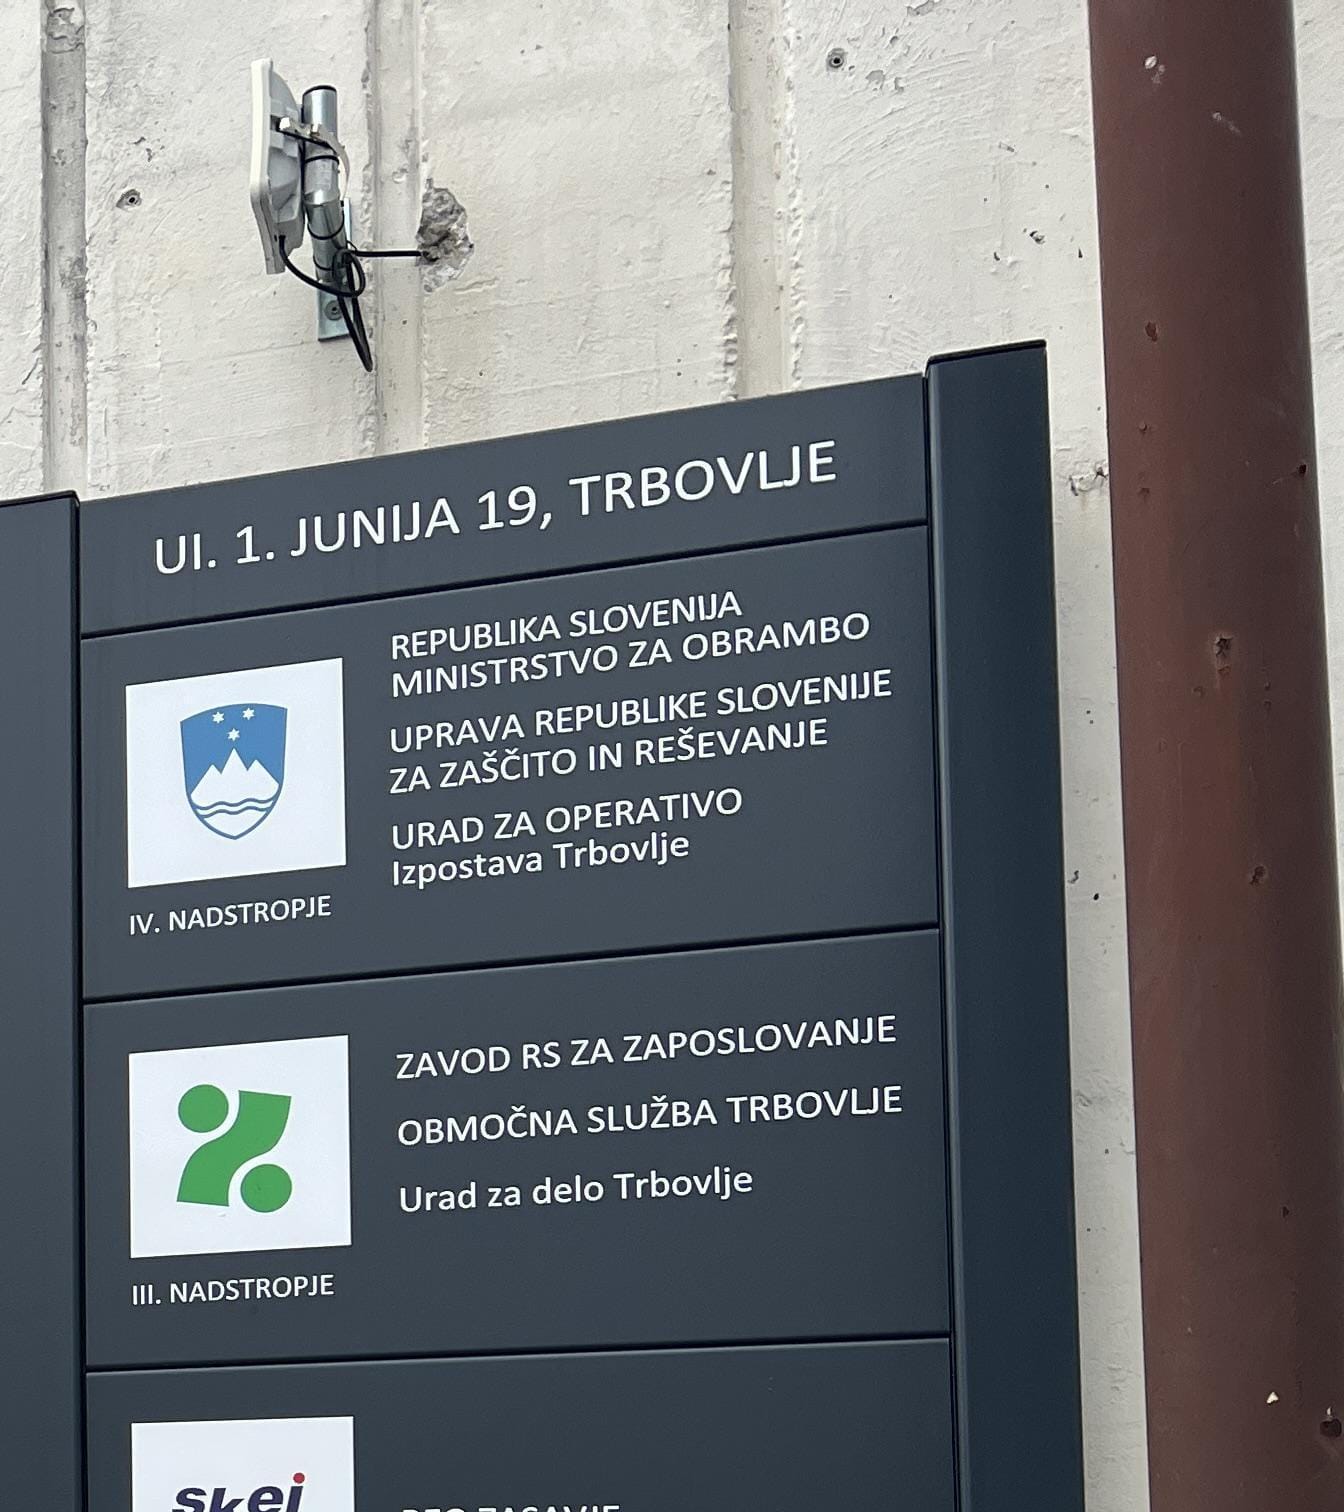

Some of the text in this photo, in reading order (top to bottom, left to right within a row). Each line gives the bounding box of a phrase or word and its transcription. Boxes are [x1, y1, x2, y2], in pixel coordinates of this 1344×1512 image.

[236, 525, 275, 564] 1.
[290, 497, 460, 557] JUNIJA
[478, 485, 552, 530] 19,
[568, 440, 837, 516] TRBOVLJE
[391, 591, 743, 660] REPUBLIKA SLOVENIJA
[392, 612, 870, 698] MINISTRSTVO ZA OBRAMBO
[390, 668, 892, 753] UPRAVA REPUBLIKE SLOVENIJE
[389, 718, 828, 794] ZA ZAŠČITO IN REŠEVANJE
[392, 788, 743, 850] URAD ZA OPERATIVO
[393, 831, 690, 890] Izpostava Trbovlje
[130, 895, 332, 936] IV. NADSTROPJE
[396, 1015, 897, 1080] ZAVOD RS ZA ZAPOSLOVANJE
[397, 1085, 903, 1146] OBMOČNA SLUŽBA TRBOVLJE
[399, 1165, 753, 1213] Urad za delo Trbovlje
[132, 1274, 335, 1306] III. NADSTROPJE
